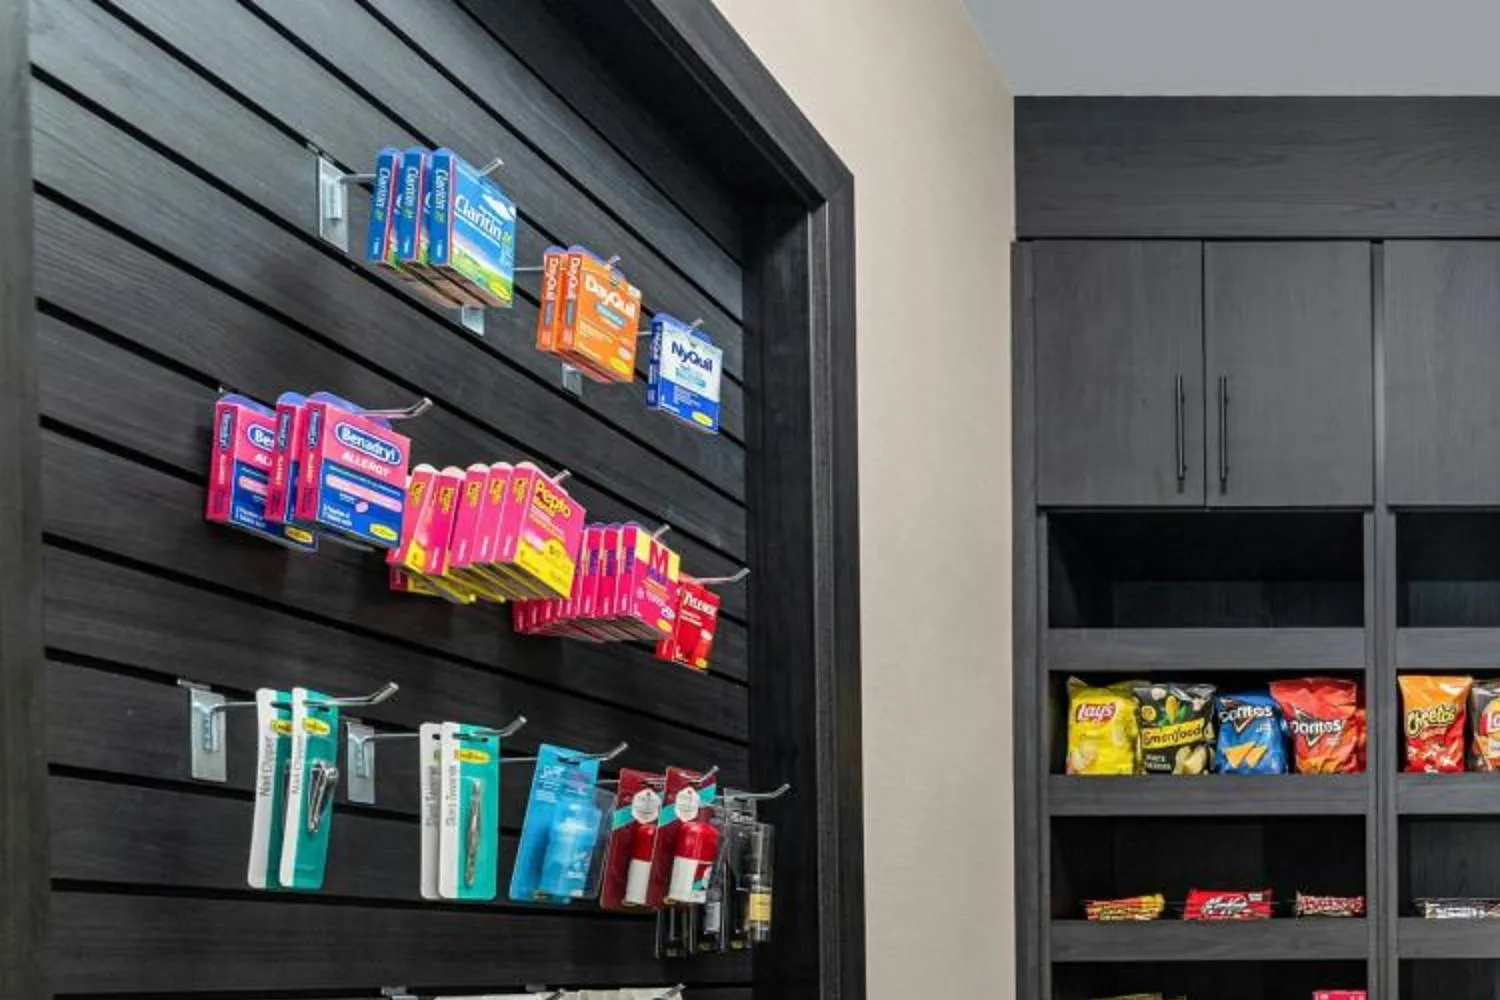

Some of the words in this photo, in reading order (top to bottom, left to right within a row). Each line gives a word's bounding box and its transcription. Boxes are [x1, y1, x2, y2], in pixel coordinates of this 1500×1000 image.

[455, 194, 501, 241] Claritin
[585, 274, 636, 317] DayQuil
[671, 341, 713, 372] NyQuil
[341, 426, 397, 463] Benadryl
[341, 452, 390, 478] ALLERGY
[535, 479, 571, 518] Pepto
[1218, 704, 1273, 723] Doritos
[1289, 719, 1344, 736] Doritos
[1407, 704, 1457, 735] Cheetos
